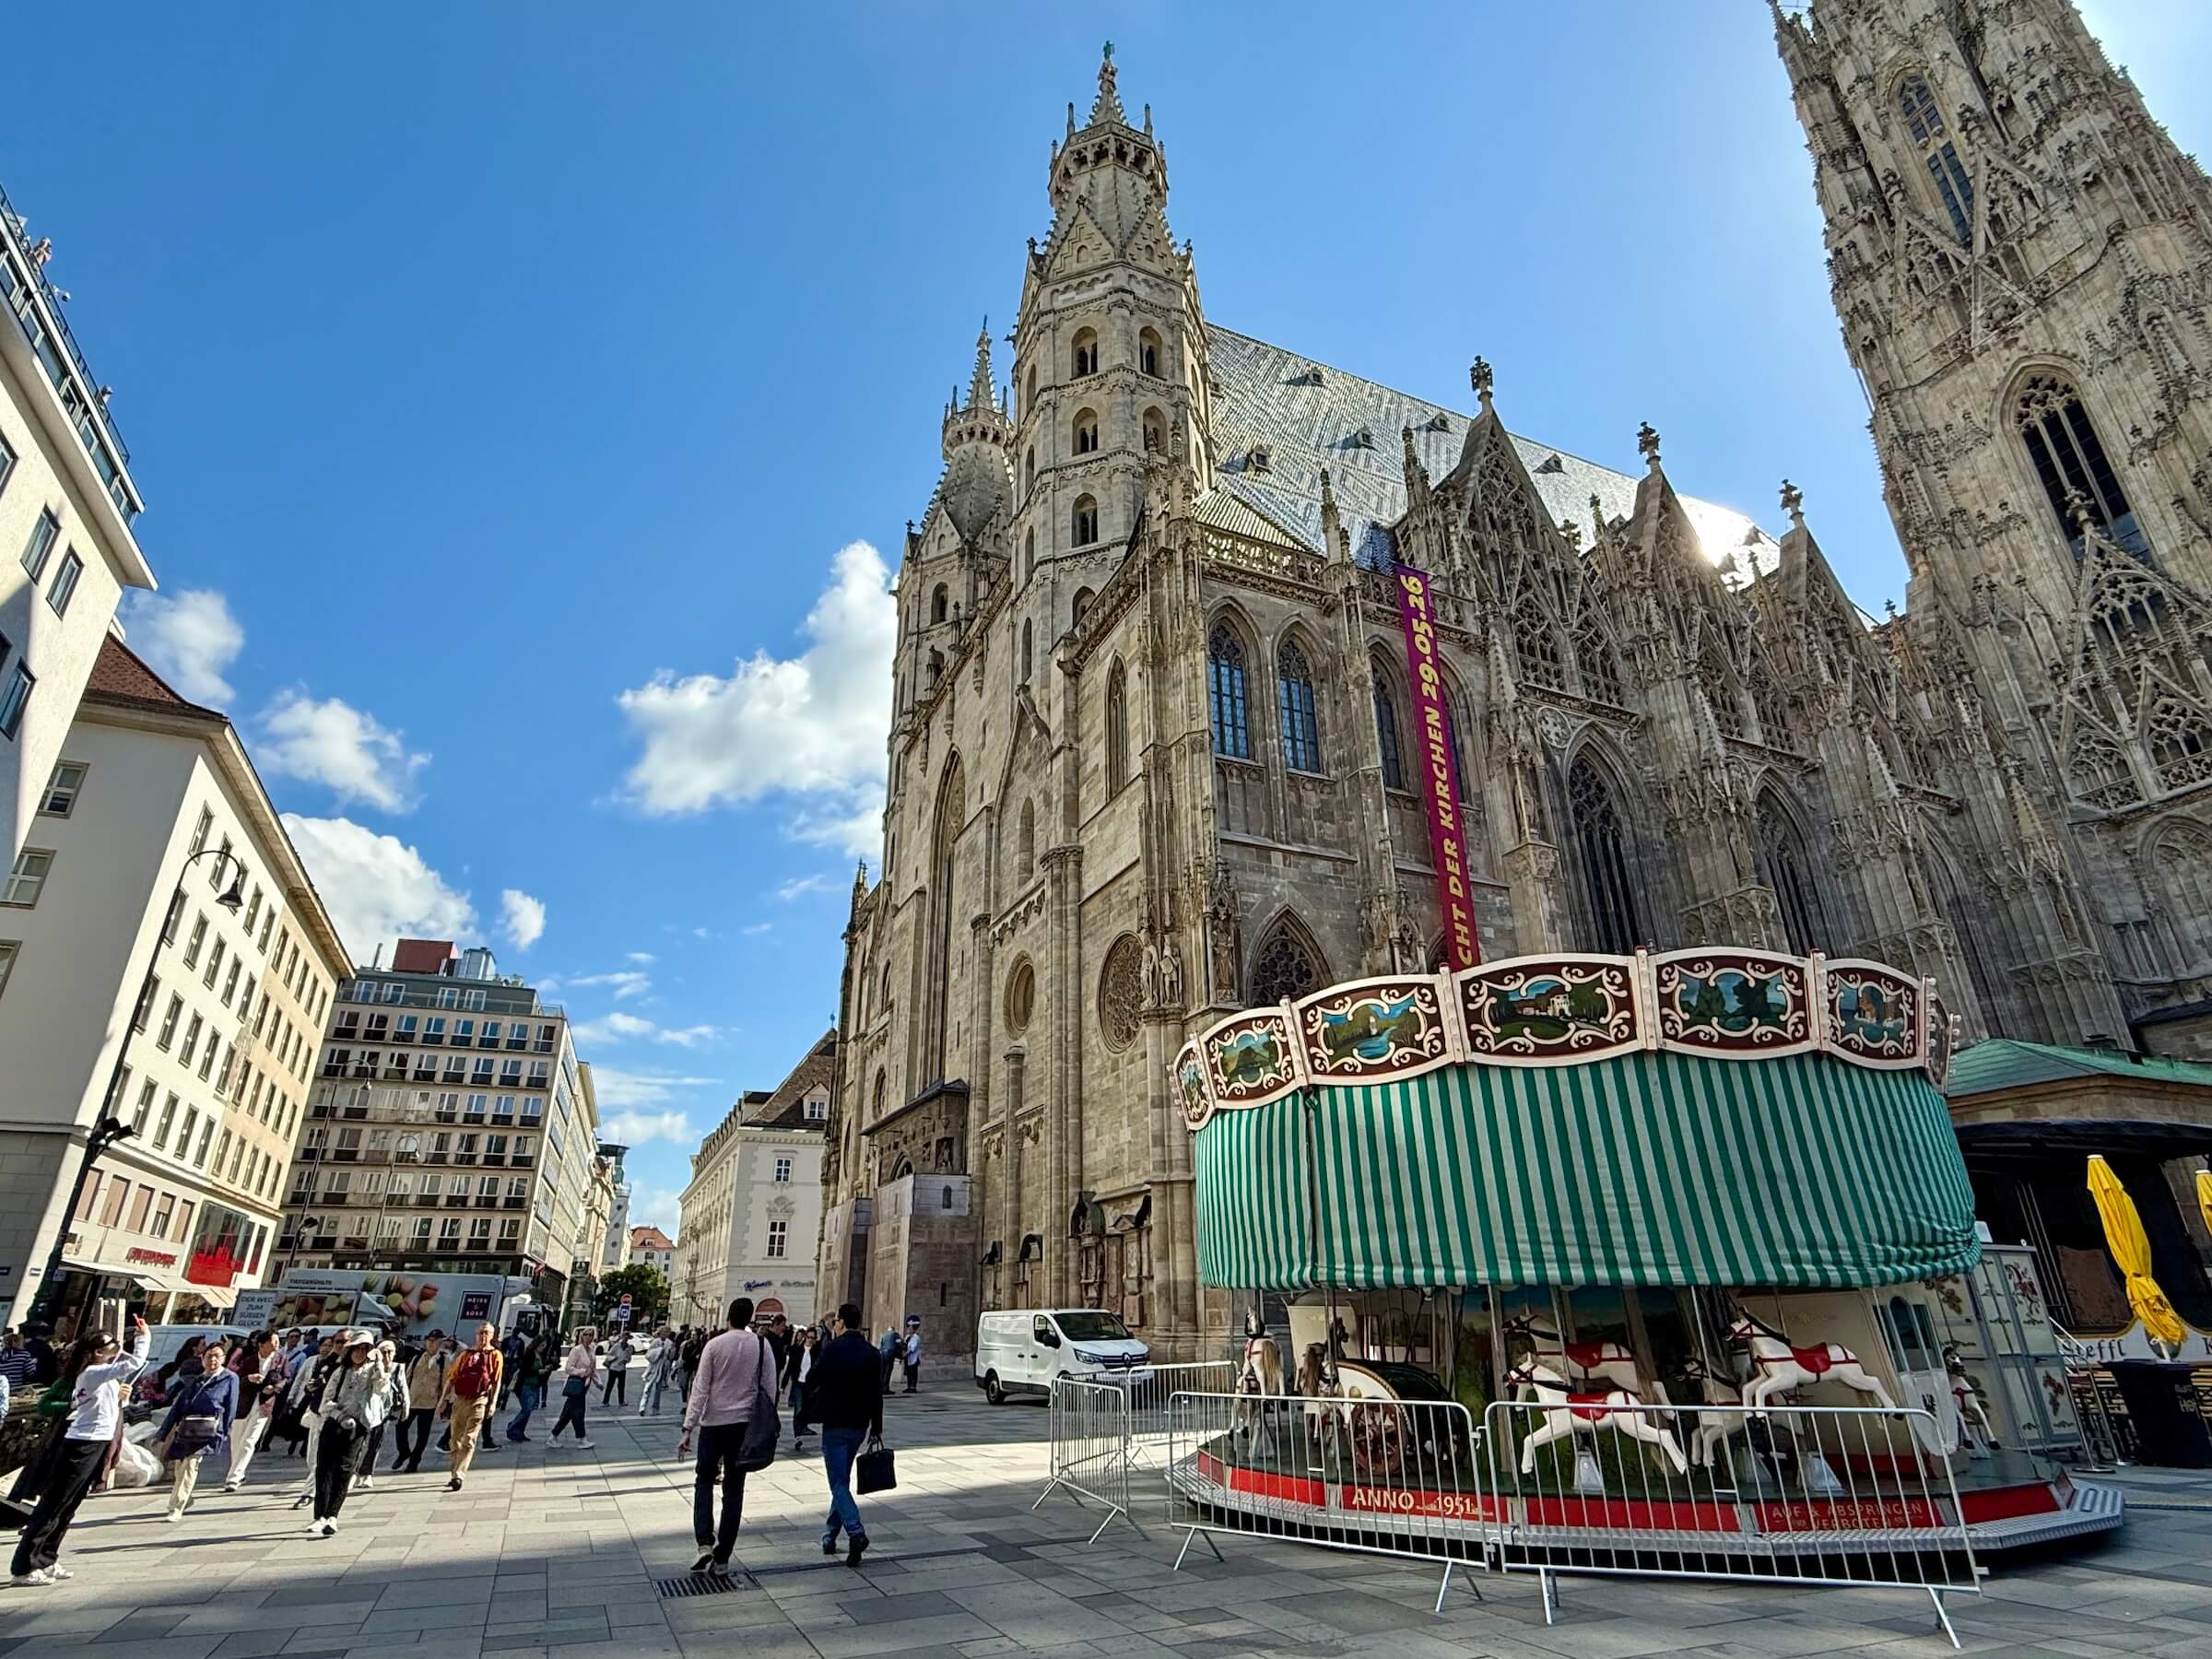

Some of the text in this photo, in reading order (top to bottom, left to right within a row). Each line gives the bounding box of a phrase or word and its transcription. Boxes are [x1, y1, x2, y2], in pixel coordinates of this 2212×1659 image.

[1400, 574, 1440, 701] 29.05.26
[1424, 706, 1454, 830] KIRCHEN
[1443, 838, 1464, 899] DER
[238, 1319, 262, 1327] GLÜCK
[2061, 1338, 2126, 1360] Steffl
[1352, 1488, 1472, 1515] ANNO 1951
[1772, 1505, 1800, 1518] AUF
